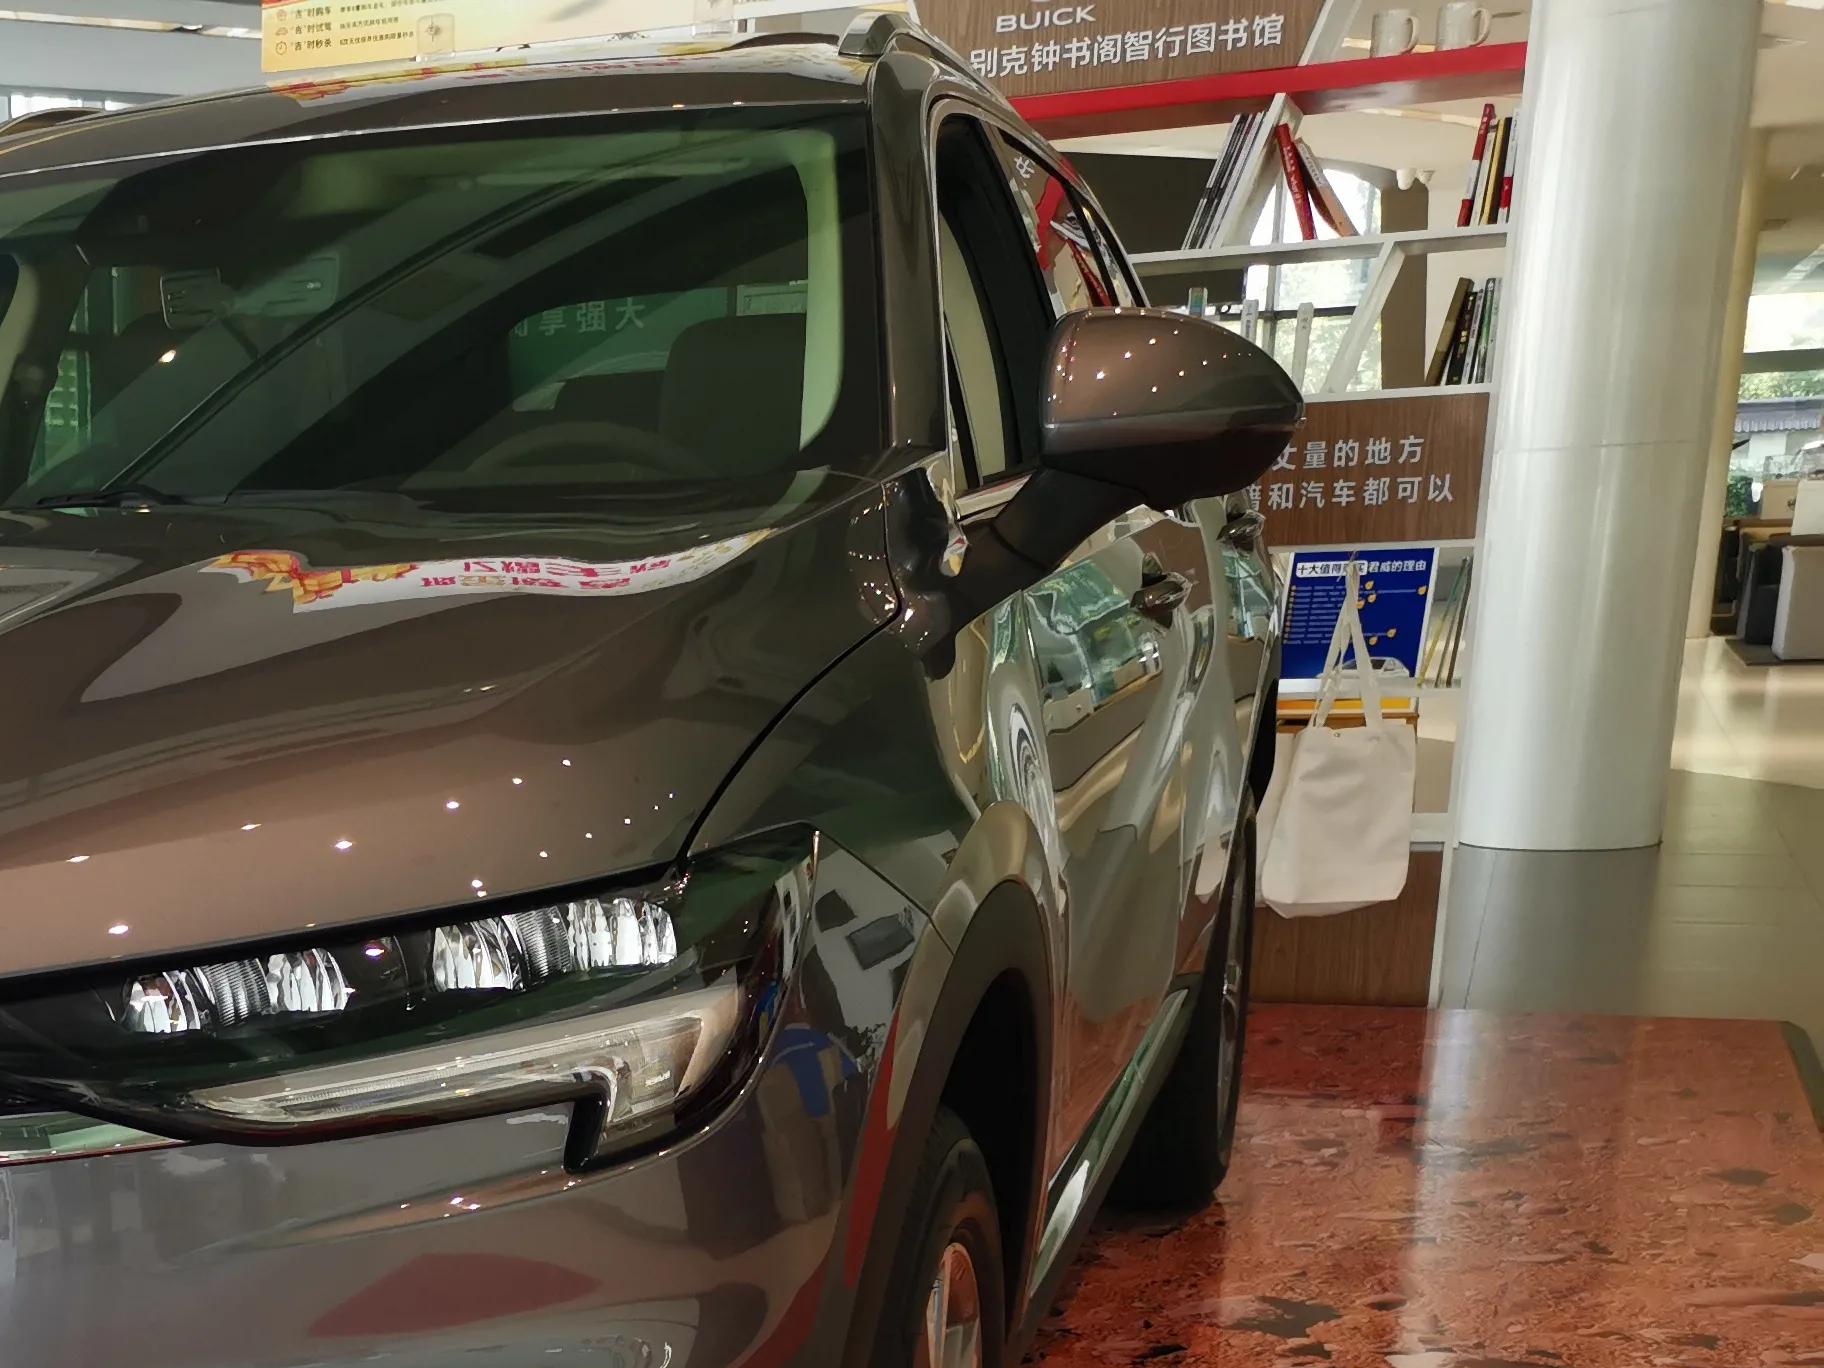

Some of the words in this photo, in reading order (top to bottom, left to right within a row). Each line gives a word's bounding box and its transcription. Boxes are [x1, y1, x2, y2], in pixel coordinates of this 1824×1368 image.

[995, 5, 1096, 33] BUICK
[970, 14, 1285, 79] 别克钟书阁智行图书馆
[1297, 560, 1427, 577] 十大值得买君威的理由
